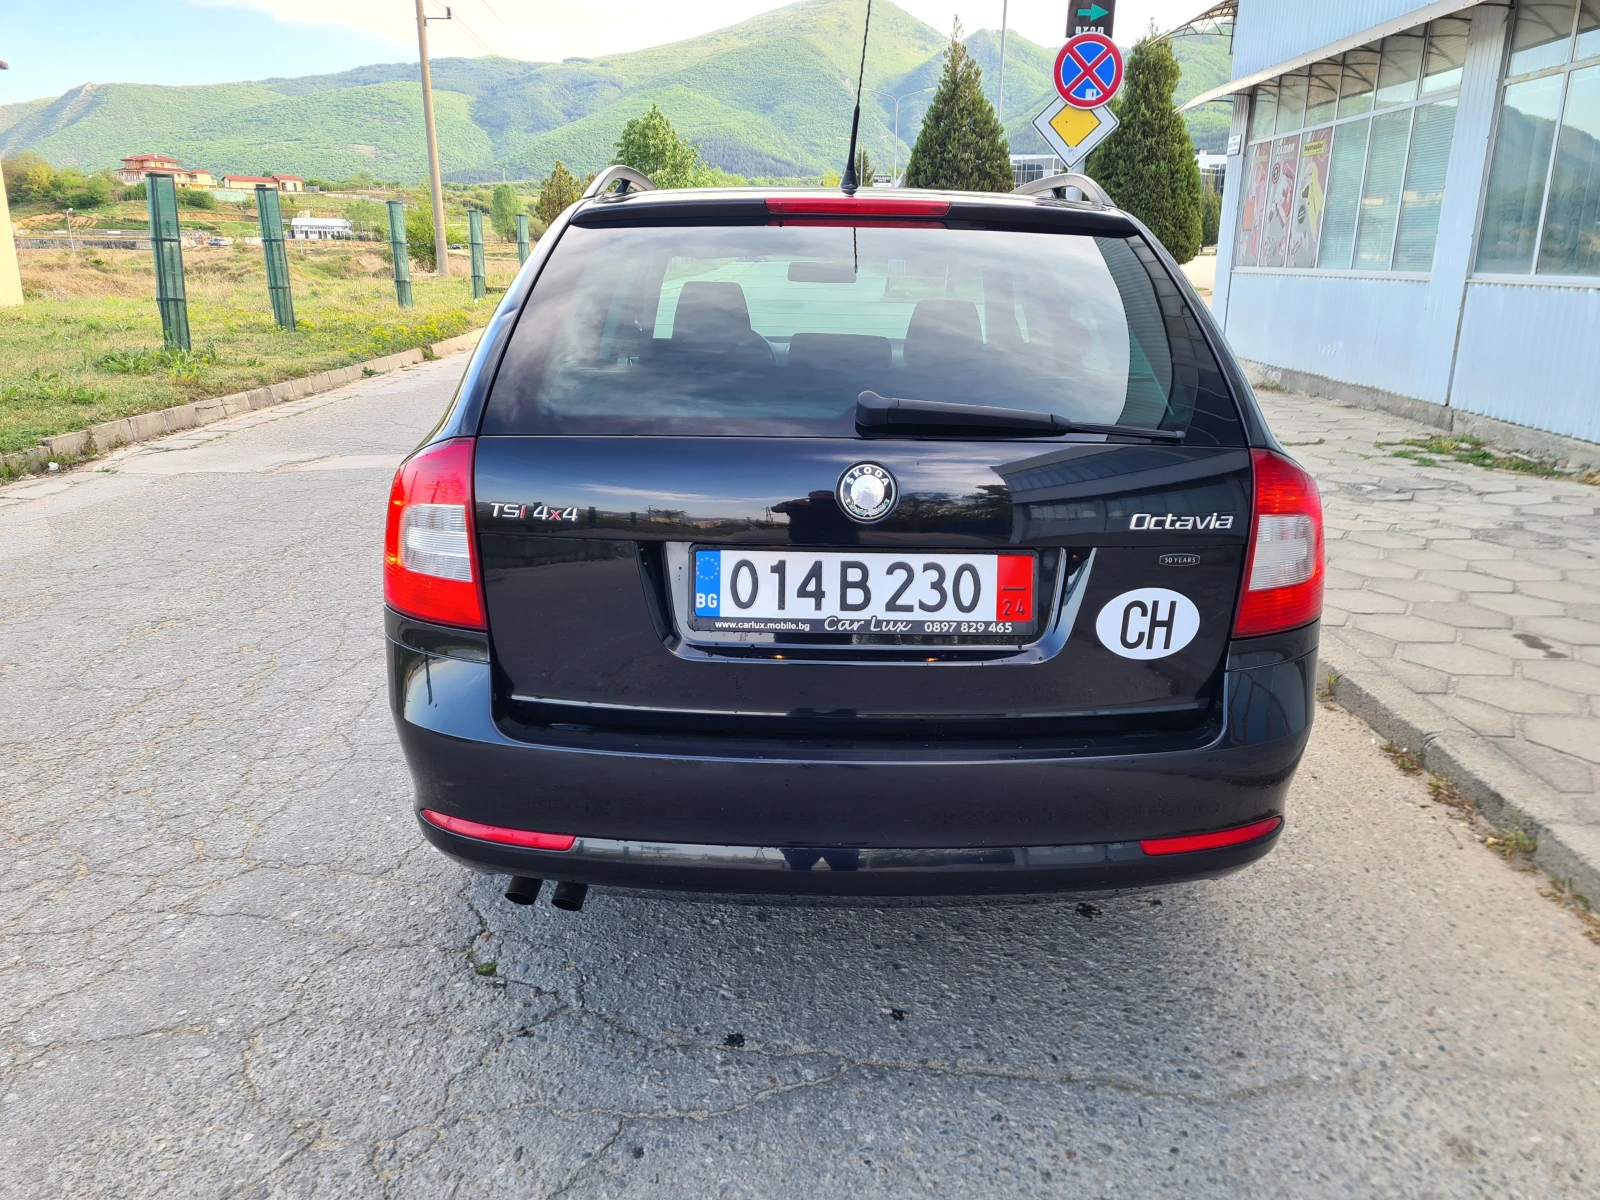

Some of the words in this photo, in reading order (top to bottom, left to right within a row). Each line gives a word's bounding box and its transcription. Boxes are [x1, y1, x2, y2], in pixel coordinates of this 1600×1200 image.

[533, 505, 579, 522] 4x4
[1129, 513, 1234, 530] Octavia
[696, 592, 718, 608] BG
[1002, 598, 1026, 616] 24
[714, 620, 811, 632] www.carlux.mobile.bg
[823, 616, 865, 632] Car
[869, 615, 913, 632] Lux
[924, 622, 957, 633] 0897
[960, 622, 986, 633] 829
[987, 623, 1013, 633] 465
[1119, 600, 1178, 650] CH
